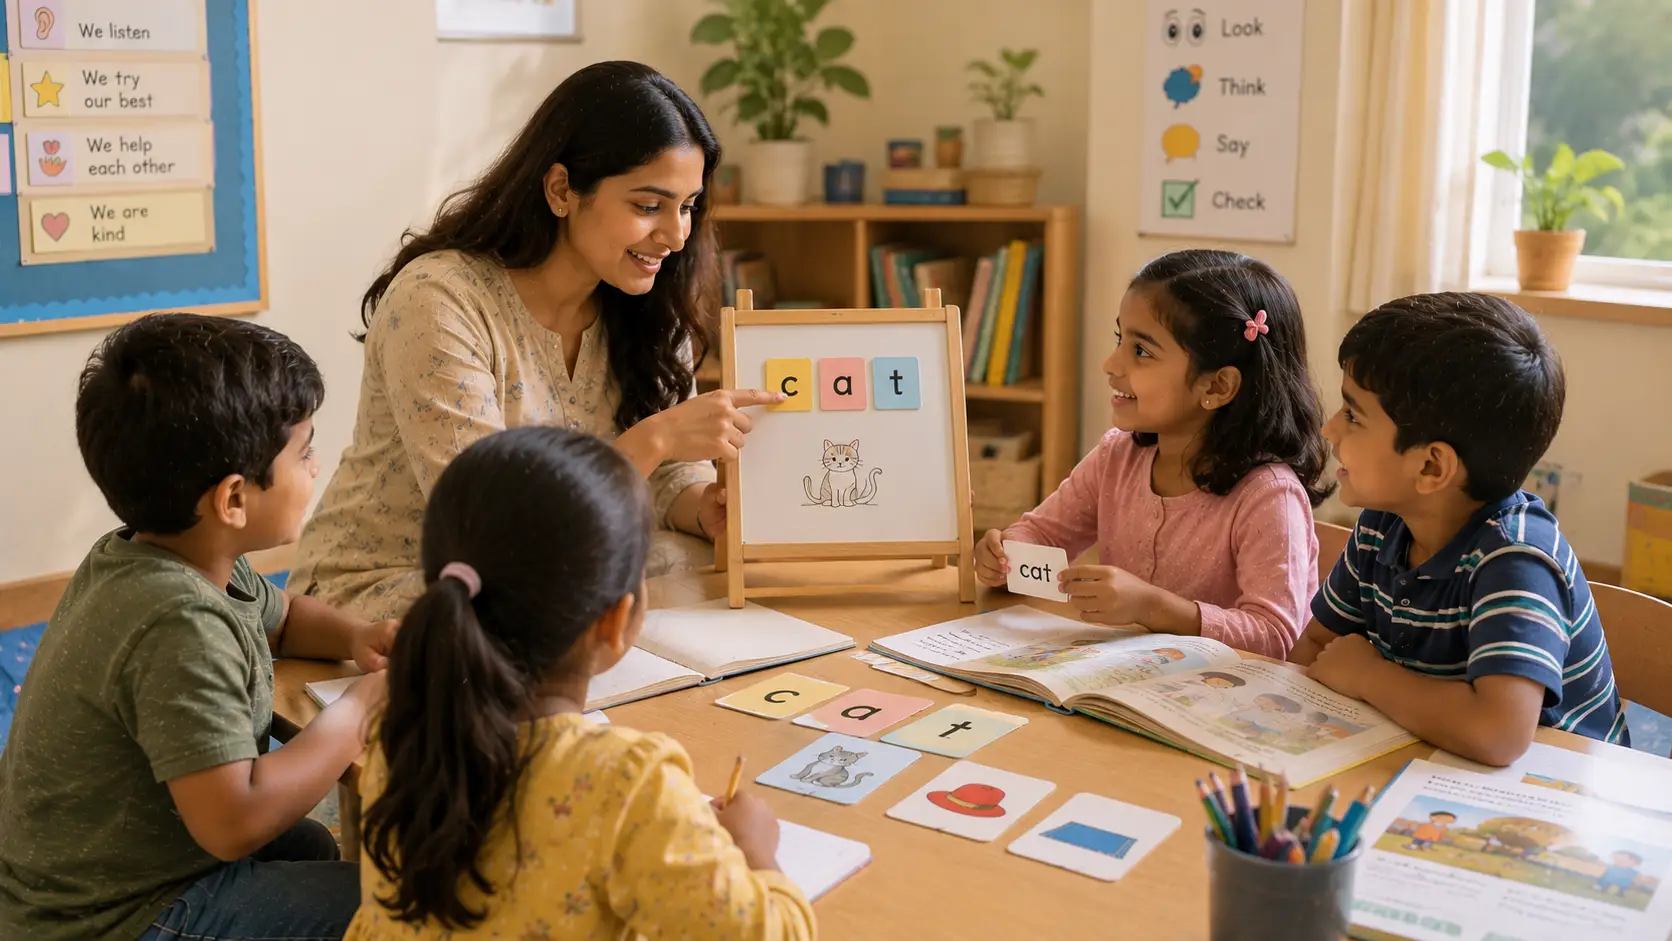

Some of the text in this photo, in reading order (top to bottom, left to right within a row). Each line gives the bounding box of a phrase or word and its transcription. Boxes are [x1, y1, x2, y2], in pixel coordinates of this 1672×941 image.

[78, 22, 151, 40] We listen
[1221, 17, 1264, 38] Look
[81, 69, 140, 90] We try
[1218, 77, 1266, 97] Think
[84, 92, 153, 109] our best
[86, 136, 153, 156] We help
[1215, 133, 1250, 159] Say
[88, 158, 176, 176] each other
[1211, 190, 1266, 211] Check
[90, 204, 149, 220] We are
[91, 225, 126, 243] kind
[1019, 563, 1052, 583] cat
